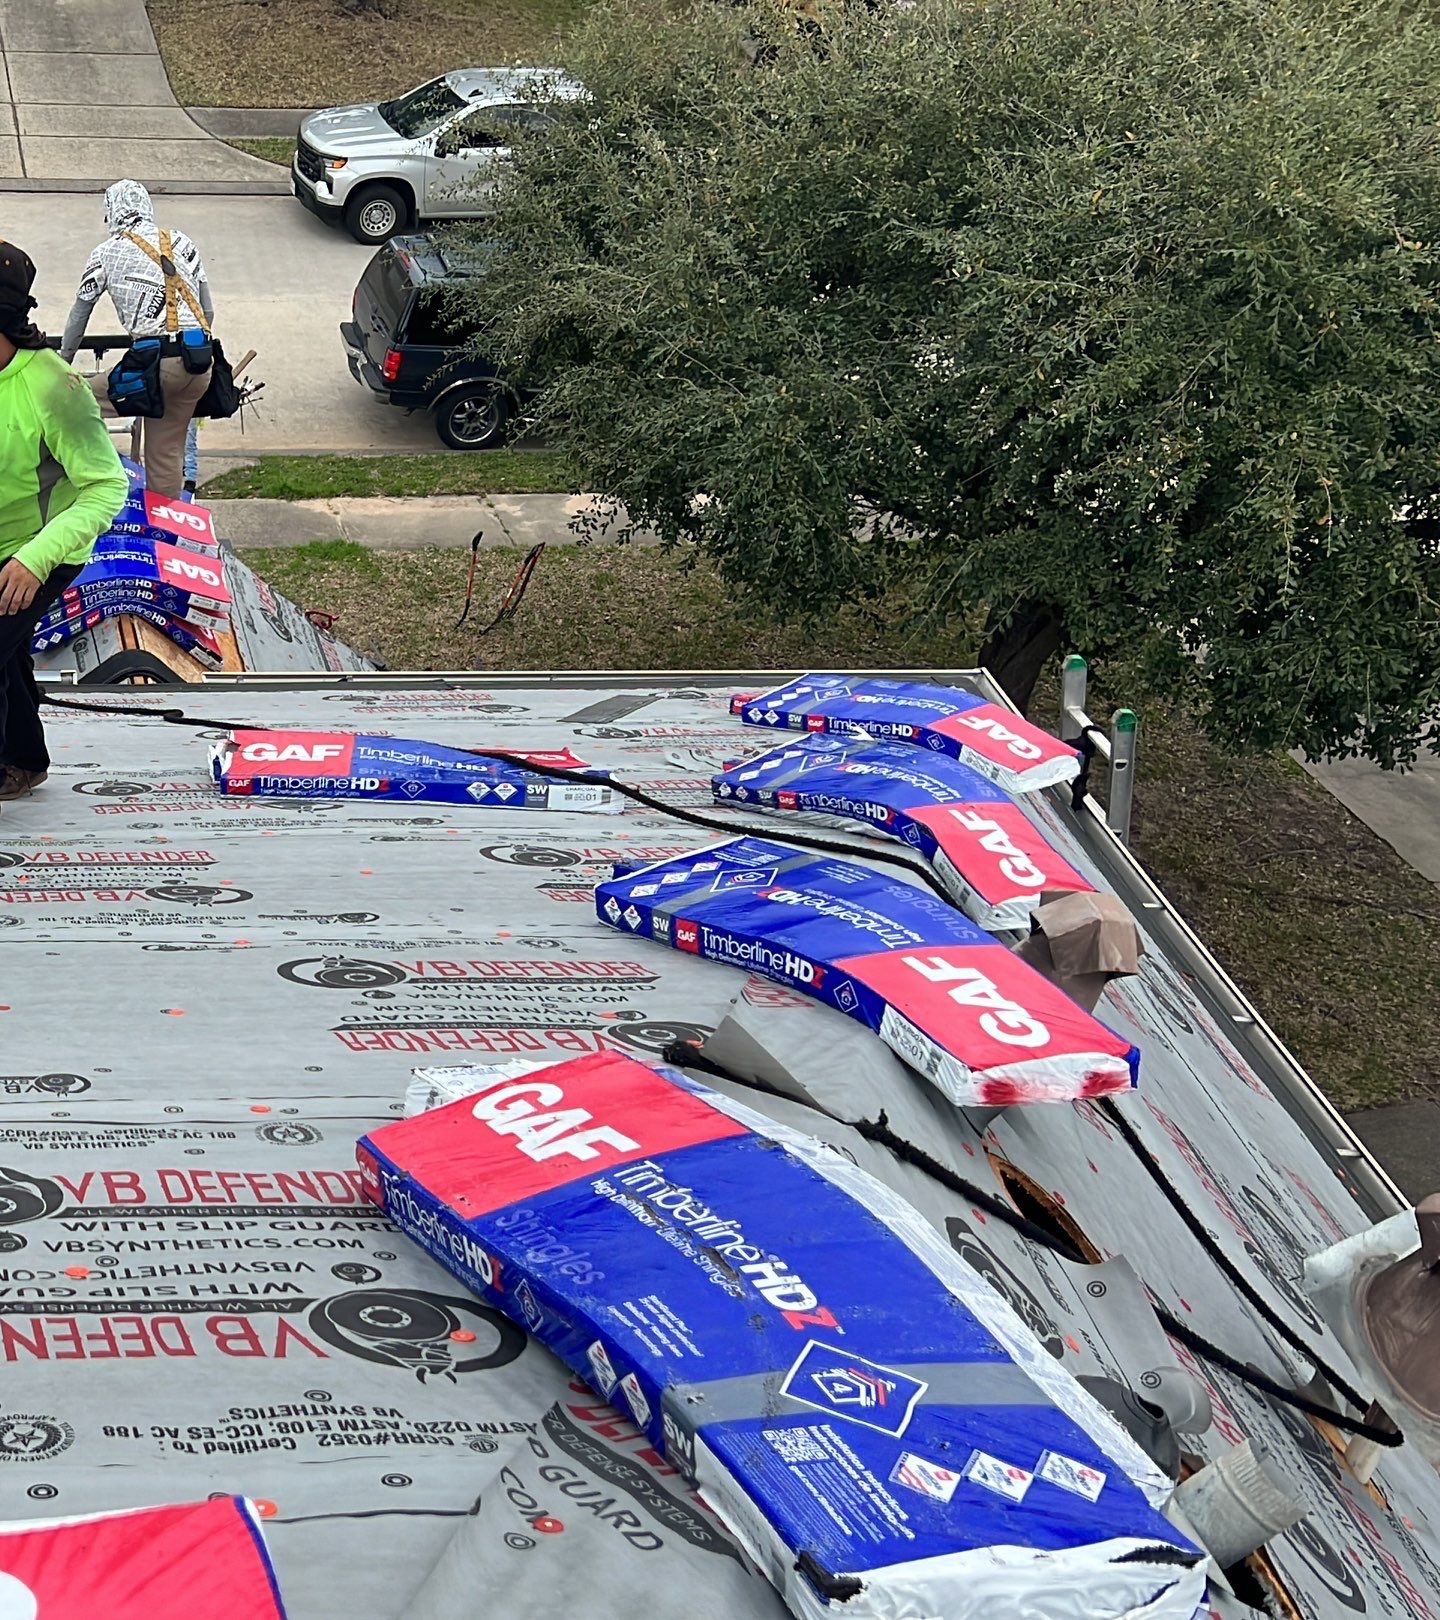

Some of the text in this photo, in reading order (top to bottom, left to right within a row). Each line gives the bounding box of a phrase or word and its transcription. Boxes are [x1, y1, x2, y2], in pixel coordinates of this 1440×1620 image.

[123, 523, 146, 534] HDZ
[151, 505, 207, 531] GAF
[163, 558, 221, 587] GAF
[63, 591, 79, 600] GAF
[788, 714, 824, 728] SW GAF
[959, 715, 1042, 761] GAF
[241, 743, 454, 768] GAF Timberline
[227, 776, 390, 791] GAF Timberline HDZ
[526, 784, 547, 795] SW
[865, 804, 896, 825] HDZ
[15, 850, 217, 862] VB DEFENDER
[949, 808, 1047, 888] GAF
[93, 891, 153, 902] VB
[803, 898, 911, 949] Timberline
[652, 916, 826, 989] SW GAF Timberline HDZ
[392, 960, 658, 977] VB DEFENDER
[405, 993, 629, 1004] VBSYNTHETICS.COM
[412, 984, 657, 992] WITH SLIP GUARD
[901, 956, 1051, 1048] GAF
[333, 1030, 547, 1051] DEFENDER
[471, 1082, 642, 1162] GAF
[53, 1170, 151, 1206] VB
[591, 1178, 618, 1197] High
[114, 1207, 307, 1217] WEATHER DEFENSE
[61, 1220, 259, 1232] WITH SLIP
[41, 1237, 365, 1254] VBSYNTHETICS.COM
[495, 1208, 606, 1286] Shingles
[613, 1160, 761, 1262] Timberline
[740, 1260, 840, 1330] HDZ
[88, 1284, 177, 1298] SLIP
[189, 1281, 306, 1297] WITH
[36, 1303, 135, 1312] DEFENSE
[139, 1301, 248, 1312] WEATHER
[205, 1314, 331, 1359] VB
[227, 1405, 404, 1421] VB SYNTHETICS
[102, 1418, 538, 1440] ASTM D226, ASTM ICC-ES AC 188
[662, 1412, 692, 1459] SW
[202, 1432, 455, 1455] CCRR#0352 Certified
[560, 1430, 636, 1482] DEFENSE
[632, 1478, 712, 1542] SYSTEMS
[539, 1463, 664, 1552] GUARD
